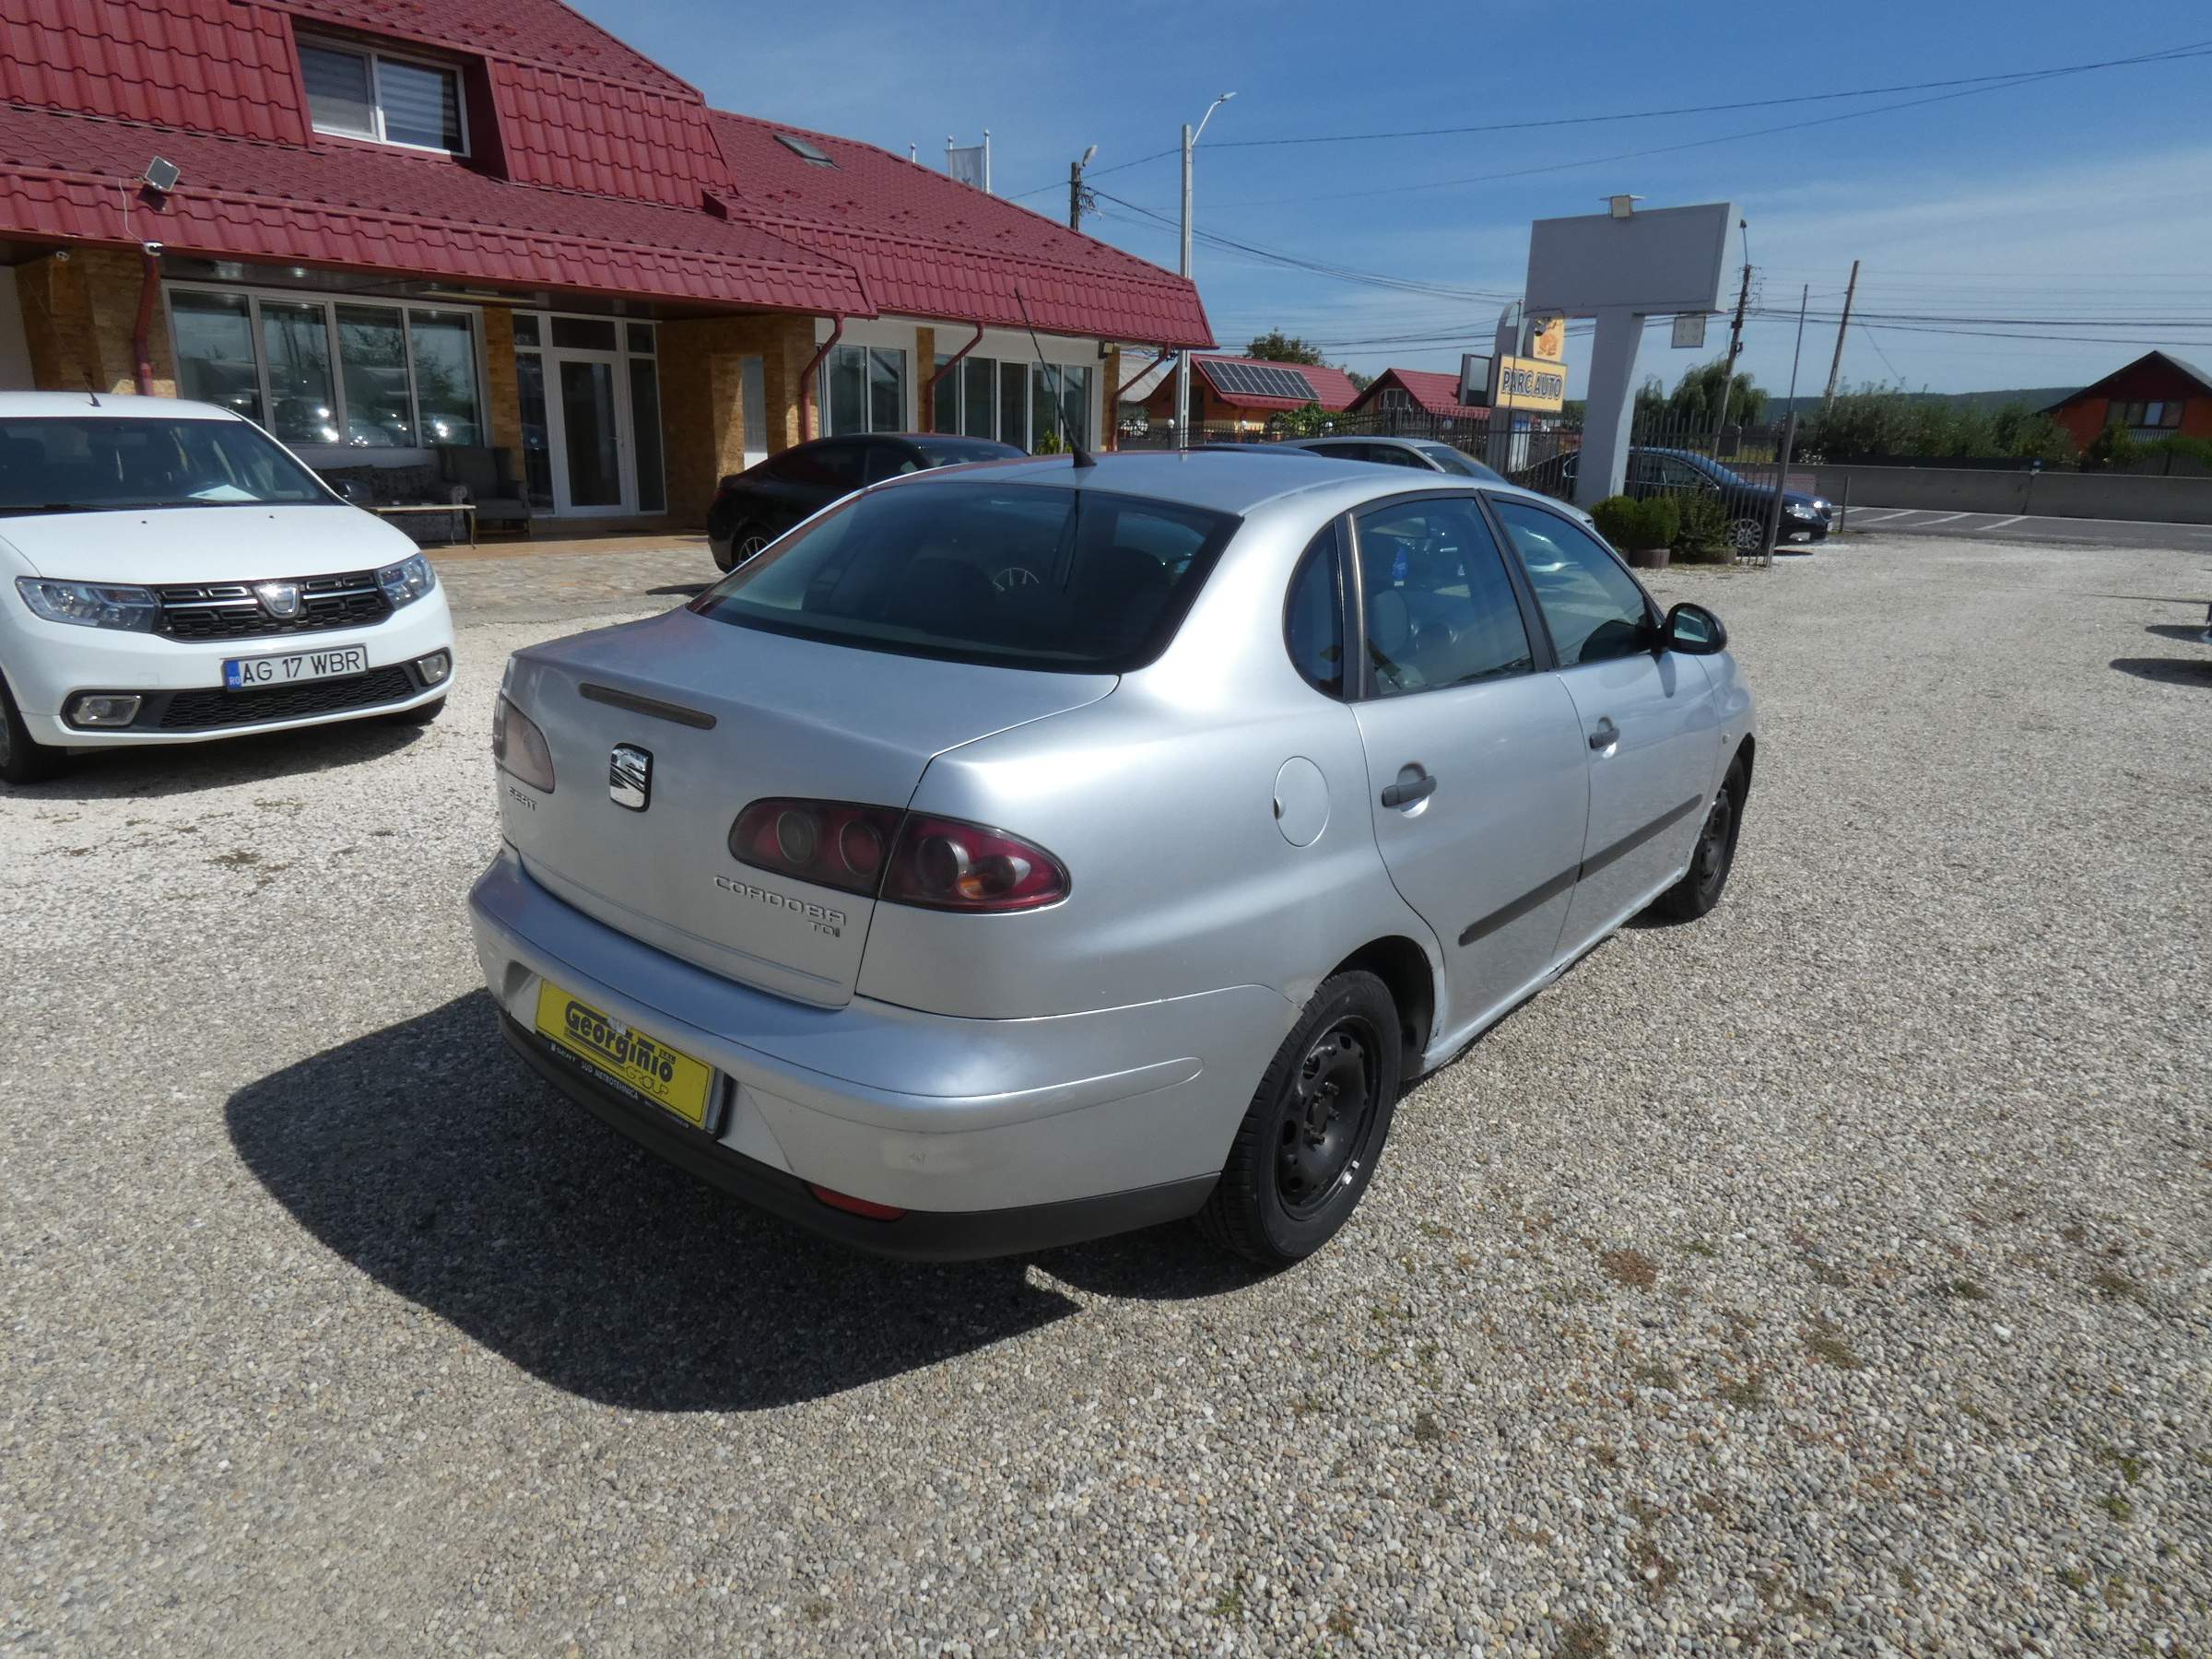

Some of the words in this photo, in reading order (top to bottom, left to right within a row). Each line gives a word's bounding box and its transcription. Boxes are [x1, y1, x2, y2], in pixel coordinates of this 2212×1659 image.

[1501, 366, 1535, 397] PARC
[1534, 371, 1563, 401] AUTO
[229, 676, 241, 686] RO
[242, 661, 273, 684] AG
[282, 656, 302, 678] 17
[311, 651, 360, 675] WBR
[713, 875, 847, 926] CORDOBA
[565, 1000, 674, 1083] Georginio
